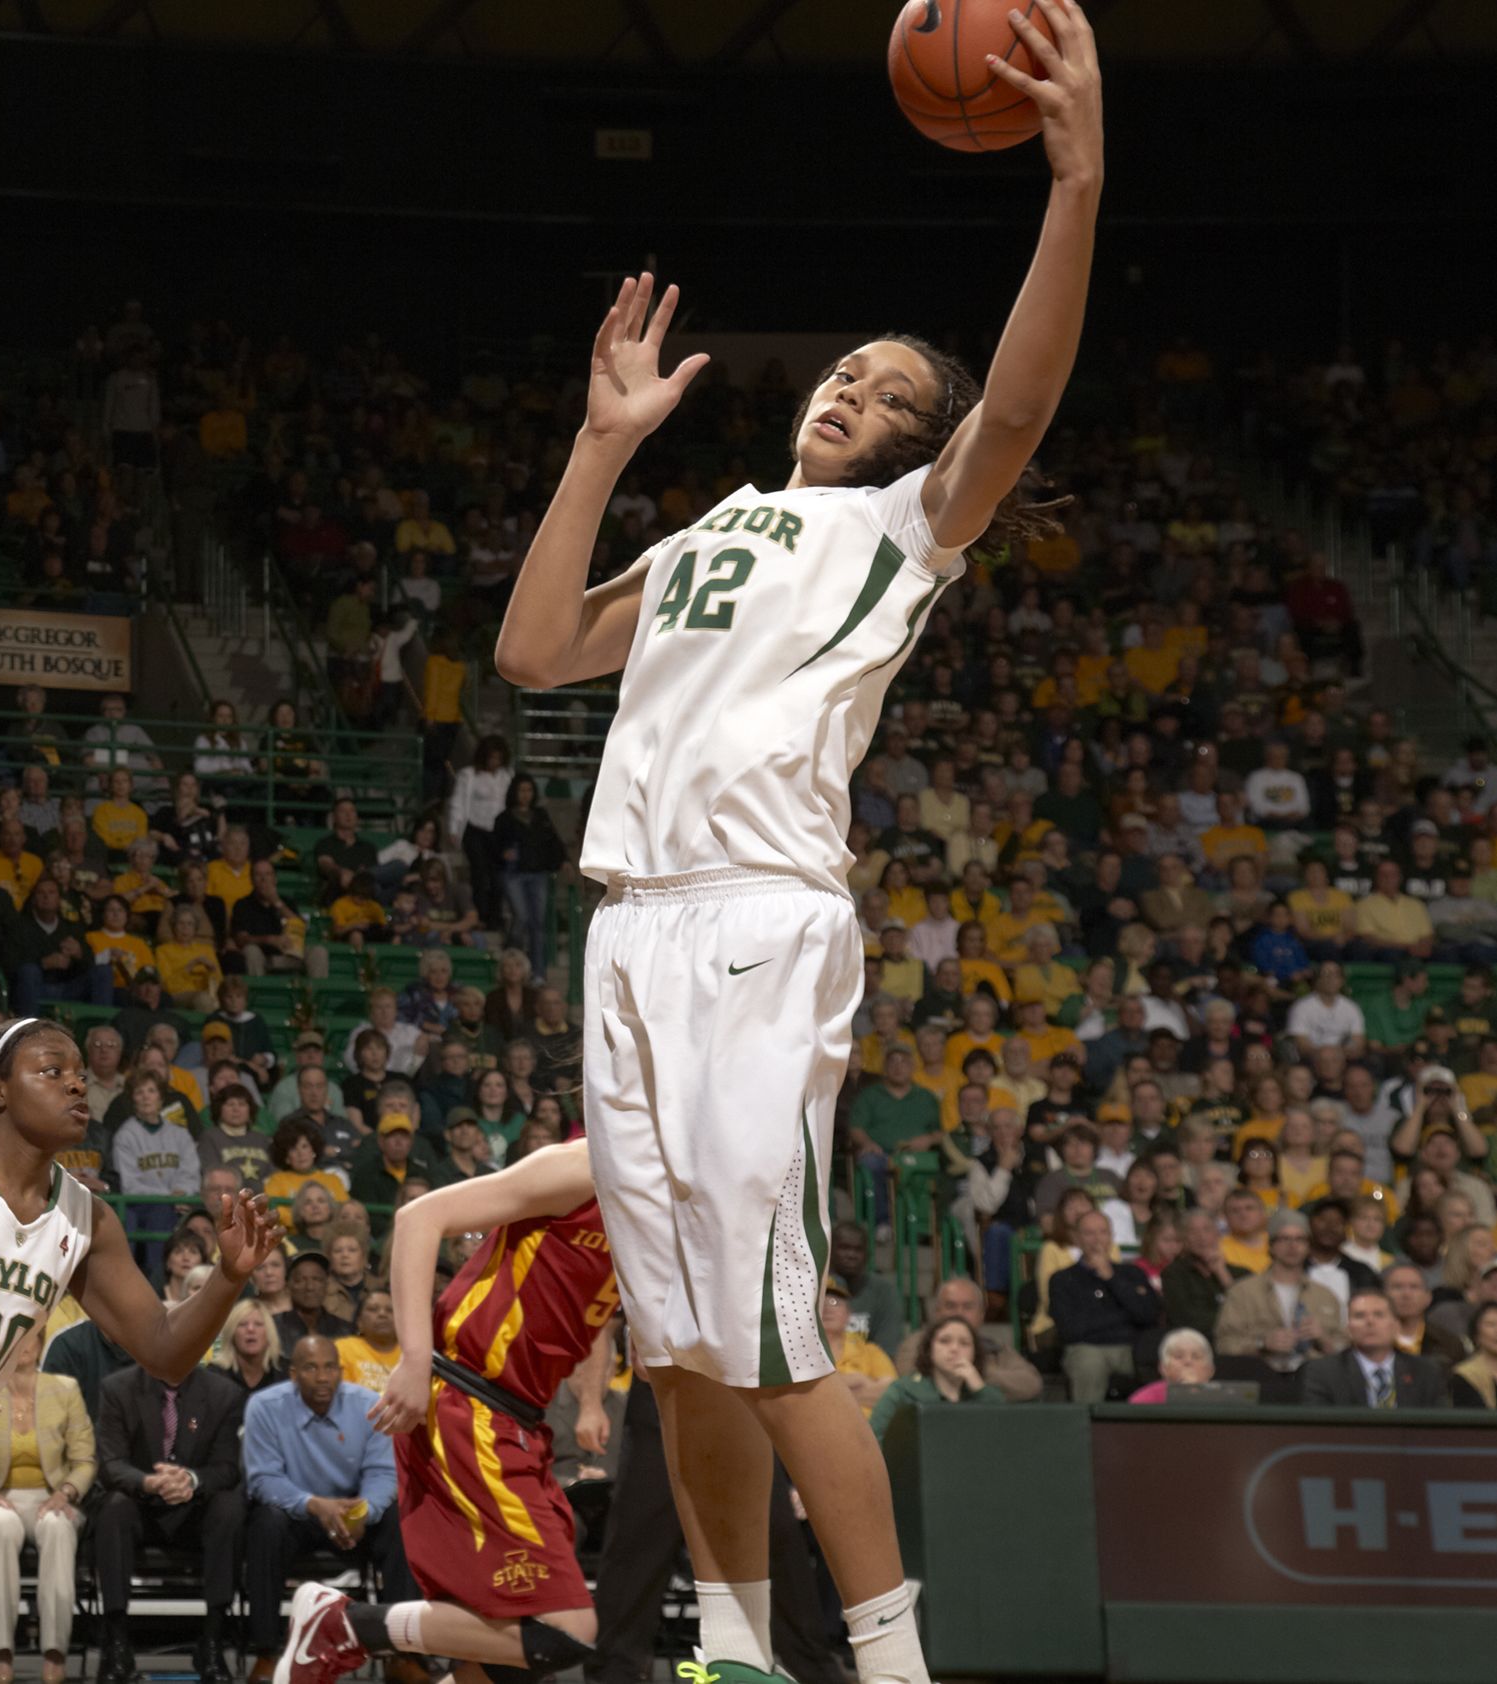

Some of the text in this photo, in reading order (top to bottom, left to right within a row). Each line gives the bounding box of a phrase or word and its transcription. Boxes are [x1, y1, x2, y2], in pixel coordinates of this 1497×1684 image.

[655, 548, 757, 635] 42
[42, 655, 124, 682] BOSQUE
[137, 1153, 181, 1172] BAYLOR
[492, 1562, 551, 1587] STATE
